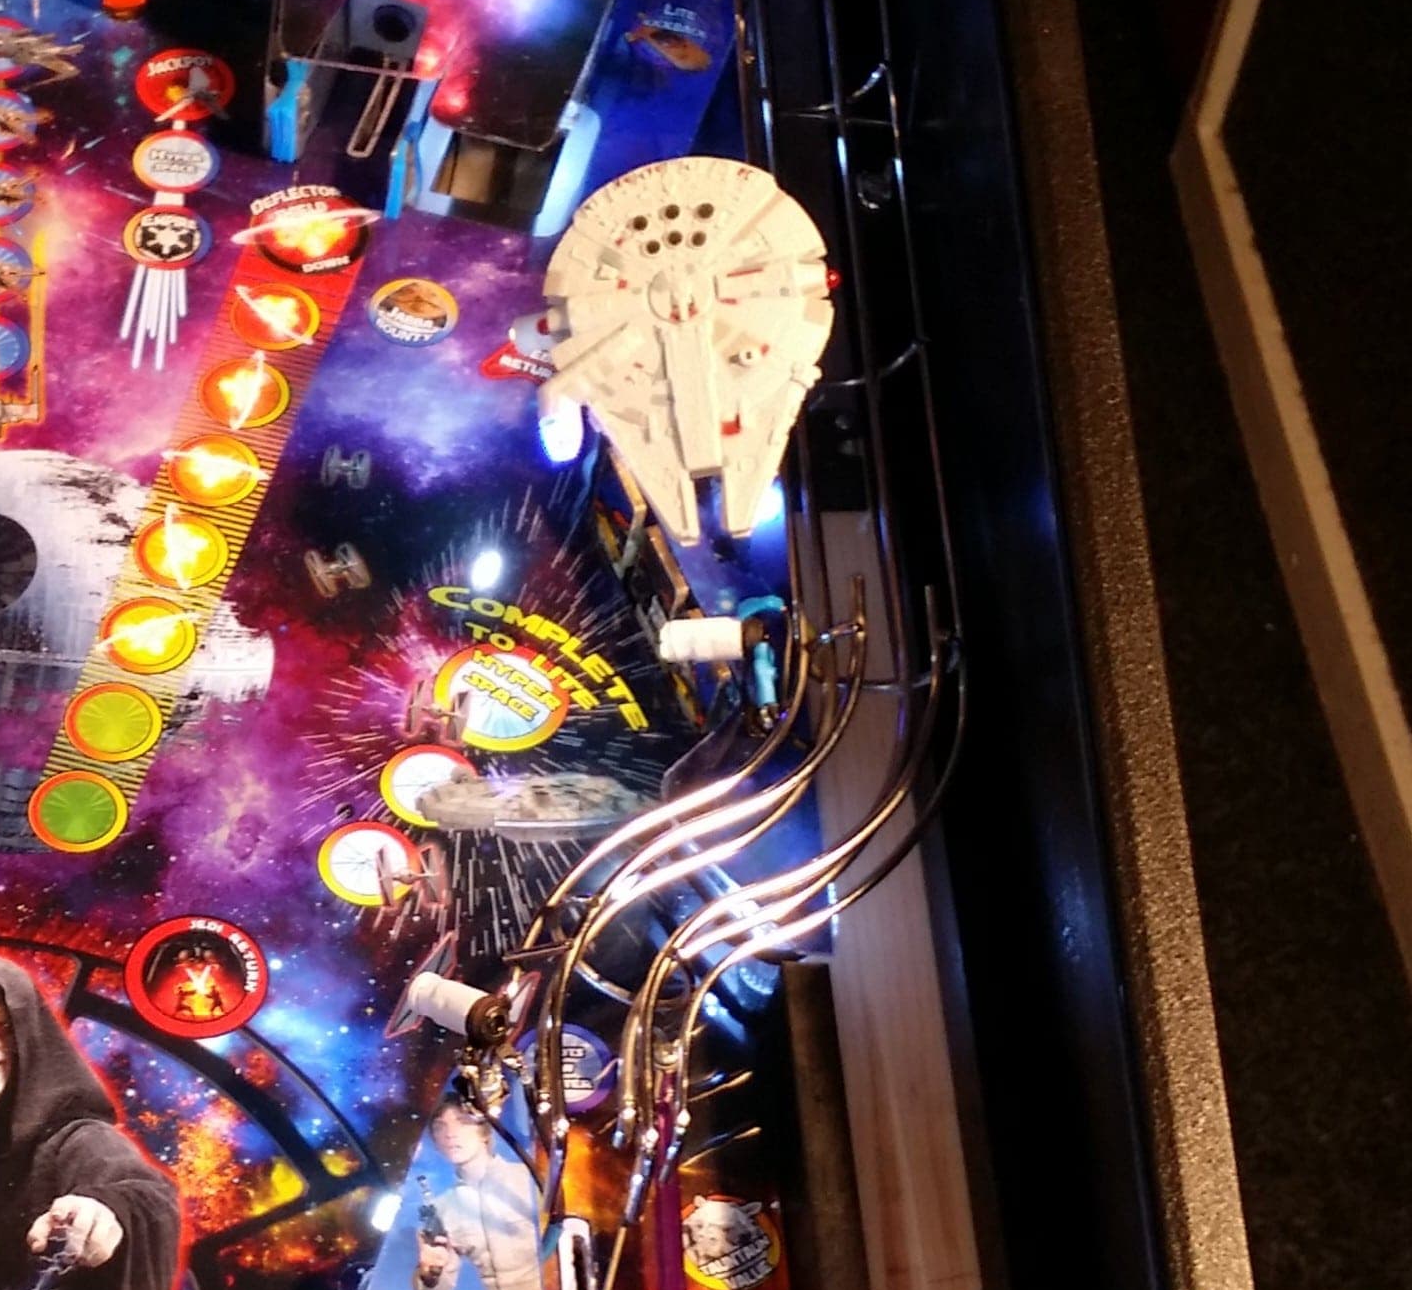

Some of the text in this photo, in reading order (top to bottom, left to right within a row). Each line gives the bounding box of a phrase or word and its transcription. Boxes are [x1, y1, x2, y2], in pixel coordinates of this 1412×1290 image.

[146, 56, 214, 77] JACKPOT
[249, 185, 342, 215] DEFLECTOR
[302, 255, 350, 273] DOWN
[375, 318, 435, 342] BOUNTY
[428, 585, 650, 732] COMPLETE
[464, 621, 600, 711] TO LITE
[462, 672, 538, 722] SPACE
[472, 649, 563, 712] HYPER
[189, 919, 261, 994] JEDI RETURN
[723, 1260, 774, 1290] VALUE
